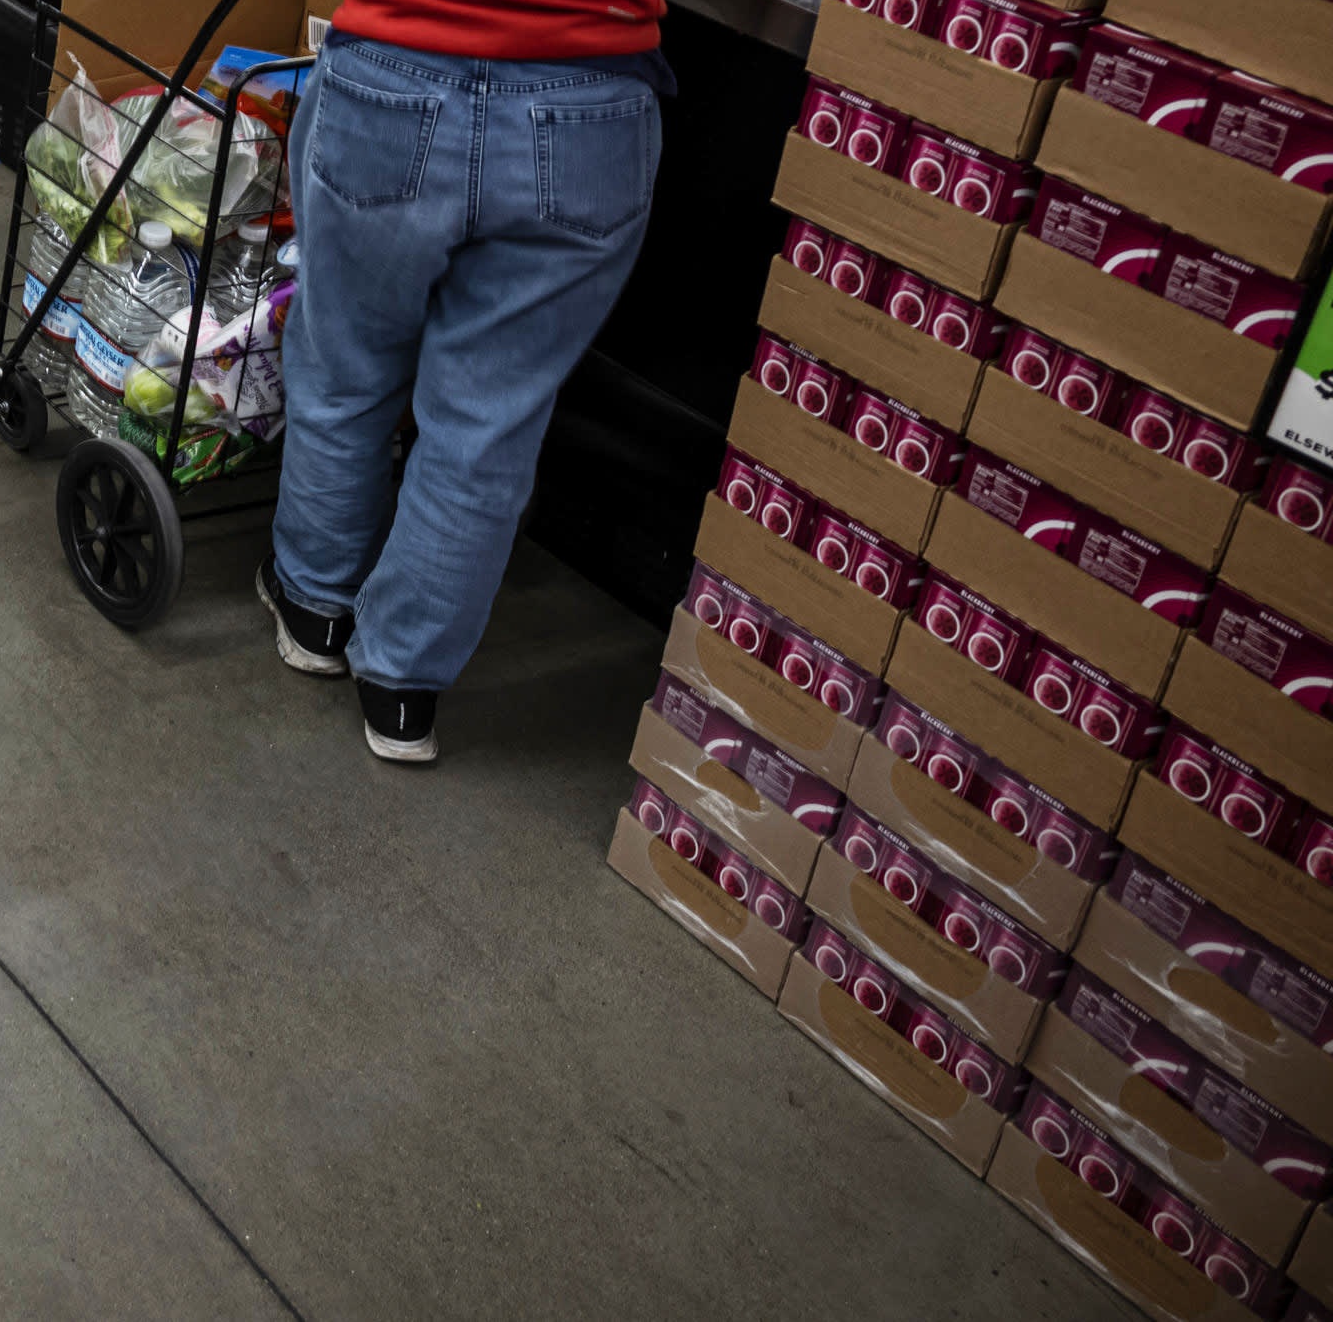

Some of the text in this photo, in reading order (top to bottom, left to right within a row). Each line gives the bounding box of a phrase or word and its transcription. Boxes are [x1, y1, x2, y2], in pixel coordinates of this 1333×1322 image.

[1127, 46, 1169, 67] BLACKBERRY
[839, 90, 873, 109] BLACKBERRY
[1259, 97, 1305, 119] BLACKBERRY
[944, 136, 980, 158] BLACKBERRY
[1081, 194, 1122, 216] BLACKBERRY
[1210, 251, 1256, 275] BLACKBERRY
[887, 398, 921, 421] BLACKBERRY
[754, 463, 783, 485] BLACKBERRY
[1005, 463, 1041, 487] BLACKBERRY
[848, 521, 880, 545] BLACKBERRY
[1121, 528, 1161, 556] BLACKBERRY
[722, 580, 751, 603] BLACKBERRY
[960, 589, 996, 615] BLACKBERRY
[1259, 611, 1304, 639] BLACKBERRY
[813, 639, 845, 663] BLACKBERRY
[1072, 658, 1110, 687] BLACKBERRY
[920, 711, 954, 739] BLACKBERRY
[1211, 744, 1254, 776] BLACKBERRY
[1028, 783, 1066, 813] BLACKBERRY
[877, 824, 910, 852] BLACKBERRY
[1165, 875, 1205, 905] BLACKBERRY
[980, 901, 1016, 931] BLACKBERRY
[1112, 992, 1151, 1023] BLACKBERRY
[1240, 1087, 1283, 1120] BLACKBERRY
[1069, 1107, 1108, 1140] BLACKBERRY
